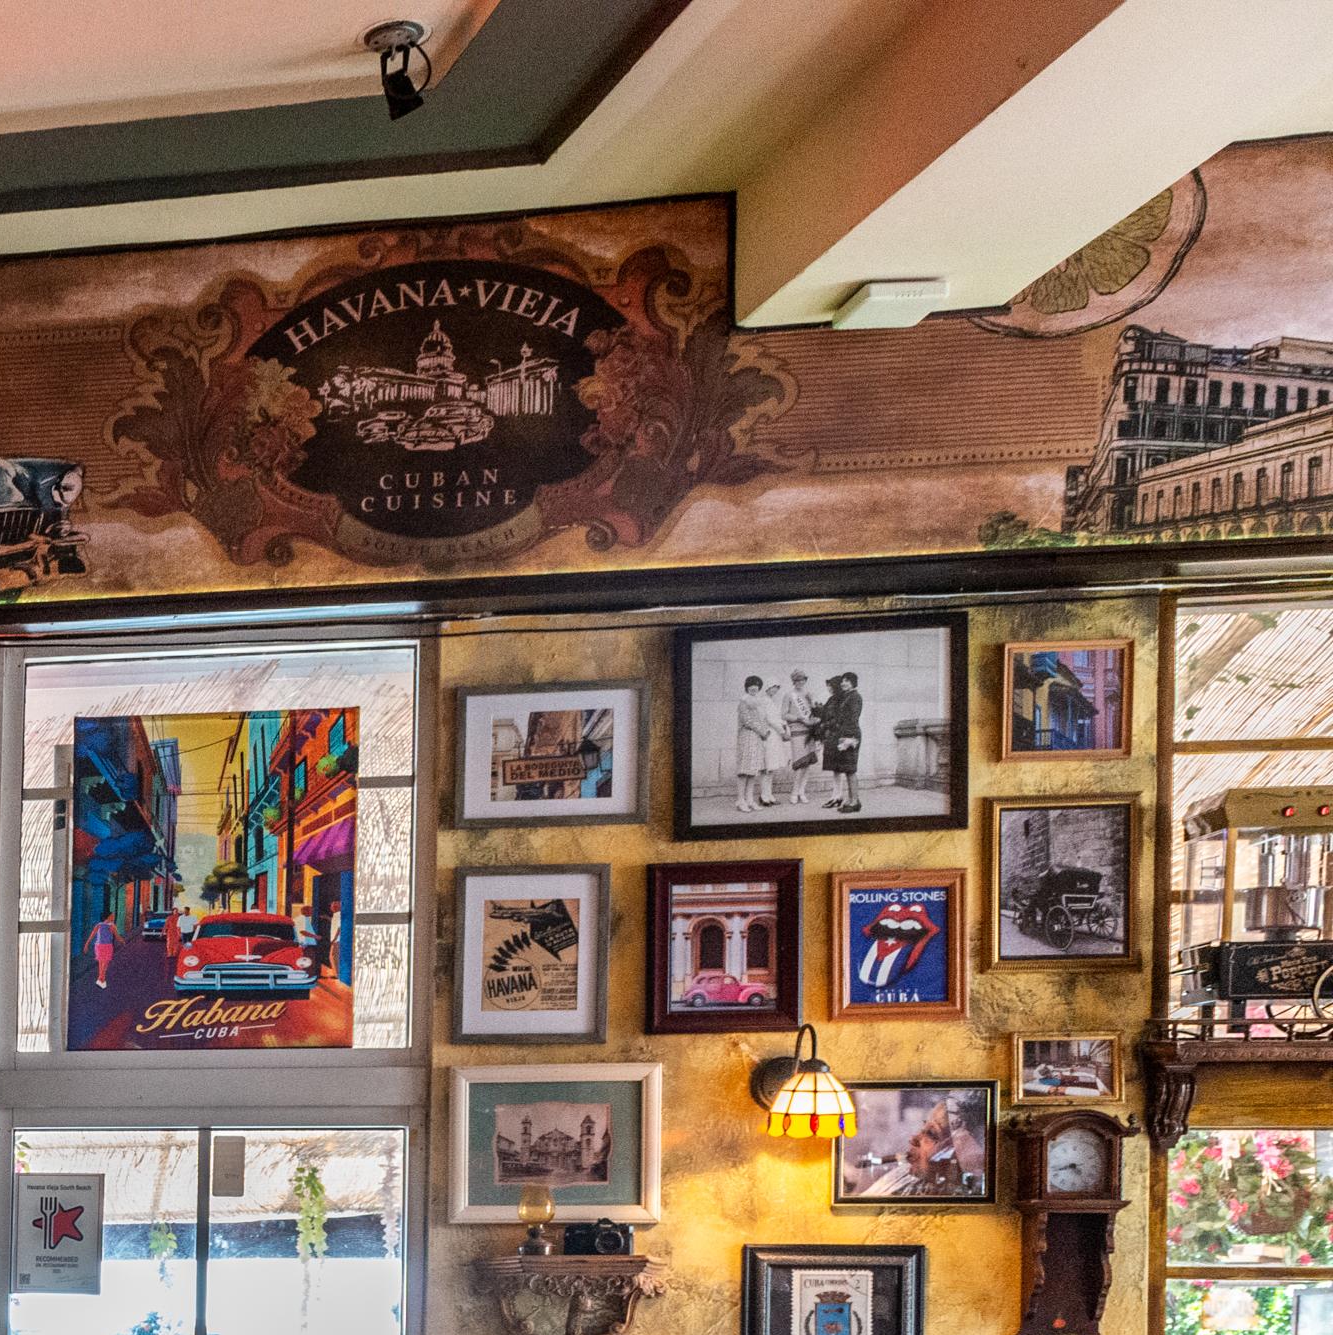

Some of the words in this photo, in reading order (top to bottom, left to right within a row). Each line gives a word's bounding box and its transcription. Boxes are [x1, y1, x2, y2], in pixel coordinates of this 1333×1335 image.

[284, 278, 456, 354] HAVANA
[475, 280, 581, 338] VIEJA
[379, 468, 498, 490] CUBAN
[360, 489, 517, 513] CUISINE
[448, 528, 515, 554] BEACH
[511, 770, 534, 780] DEL
[539, 767, 581, 778] MEDIO
[849, 893, 899, 904] ROLLING
[901, 891, 947, 902] STONES
[487, 973, 538, 998] HAVANA
[875, 992, 920, 1003] CUBA
[136, 994, 287, 1033] Habana
[194, 1026, 239, 1039] CUBA
[804, 1279, 824, 1288] CUBA
